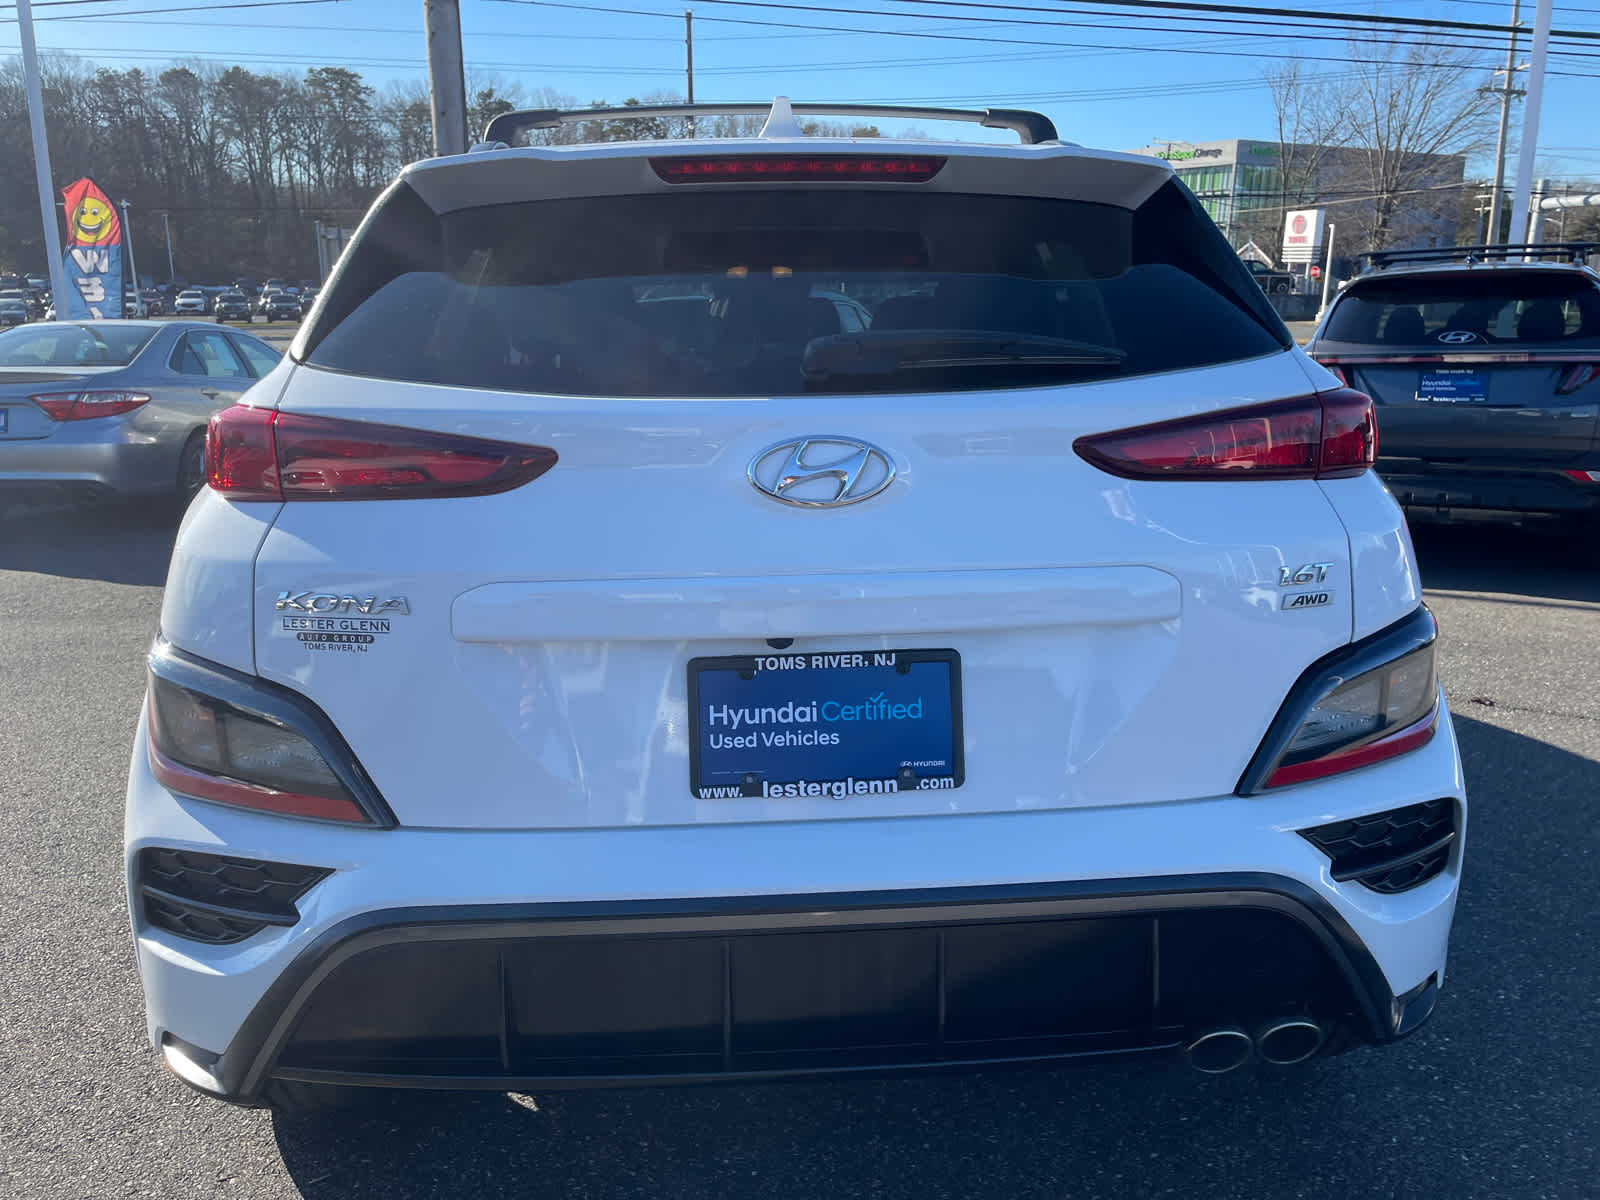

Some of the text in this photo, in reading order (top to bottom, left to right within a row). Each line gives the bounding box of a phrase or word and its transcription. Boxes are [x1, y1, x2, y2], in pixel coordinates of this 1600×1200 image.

[275, 591, 410, 616] KONA
[1291, 593, 1329, 607] AWD
[283, 617, 391, 632] LESTER GLENN
[299, 633, 373, 643] AUTO GROUP
[303, 642, 368, 653] TOMS RIVER, NJ
[754, 653, 897, 671] TOMS RIVER, NJ
[708, 691, 923, 730] Hyundai Certified
[709, 730, 840, 750] Used Vehicles
[699, 777, 954, 800] www. lesterglenn .com
